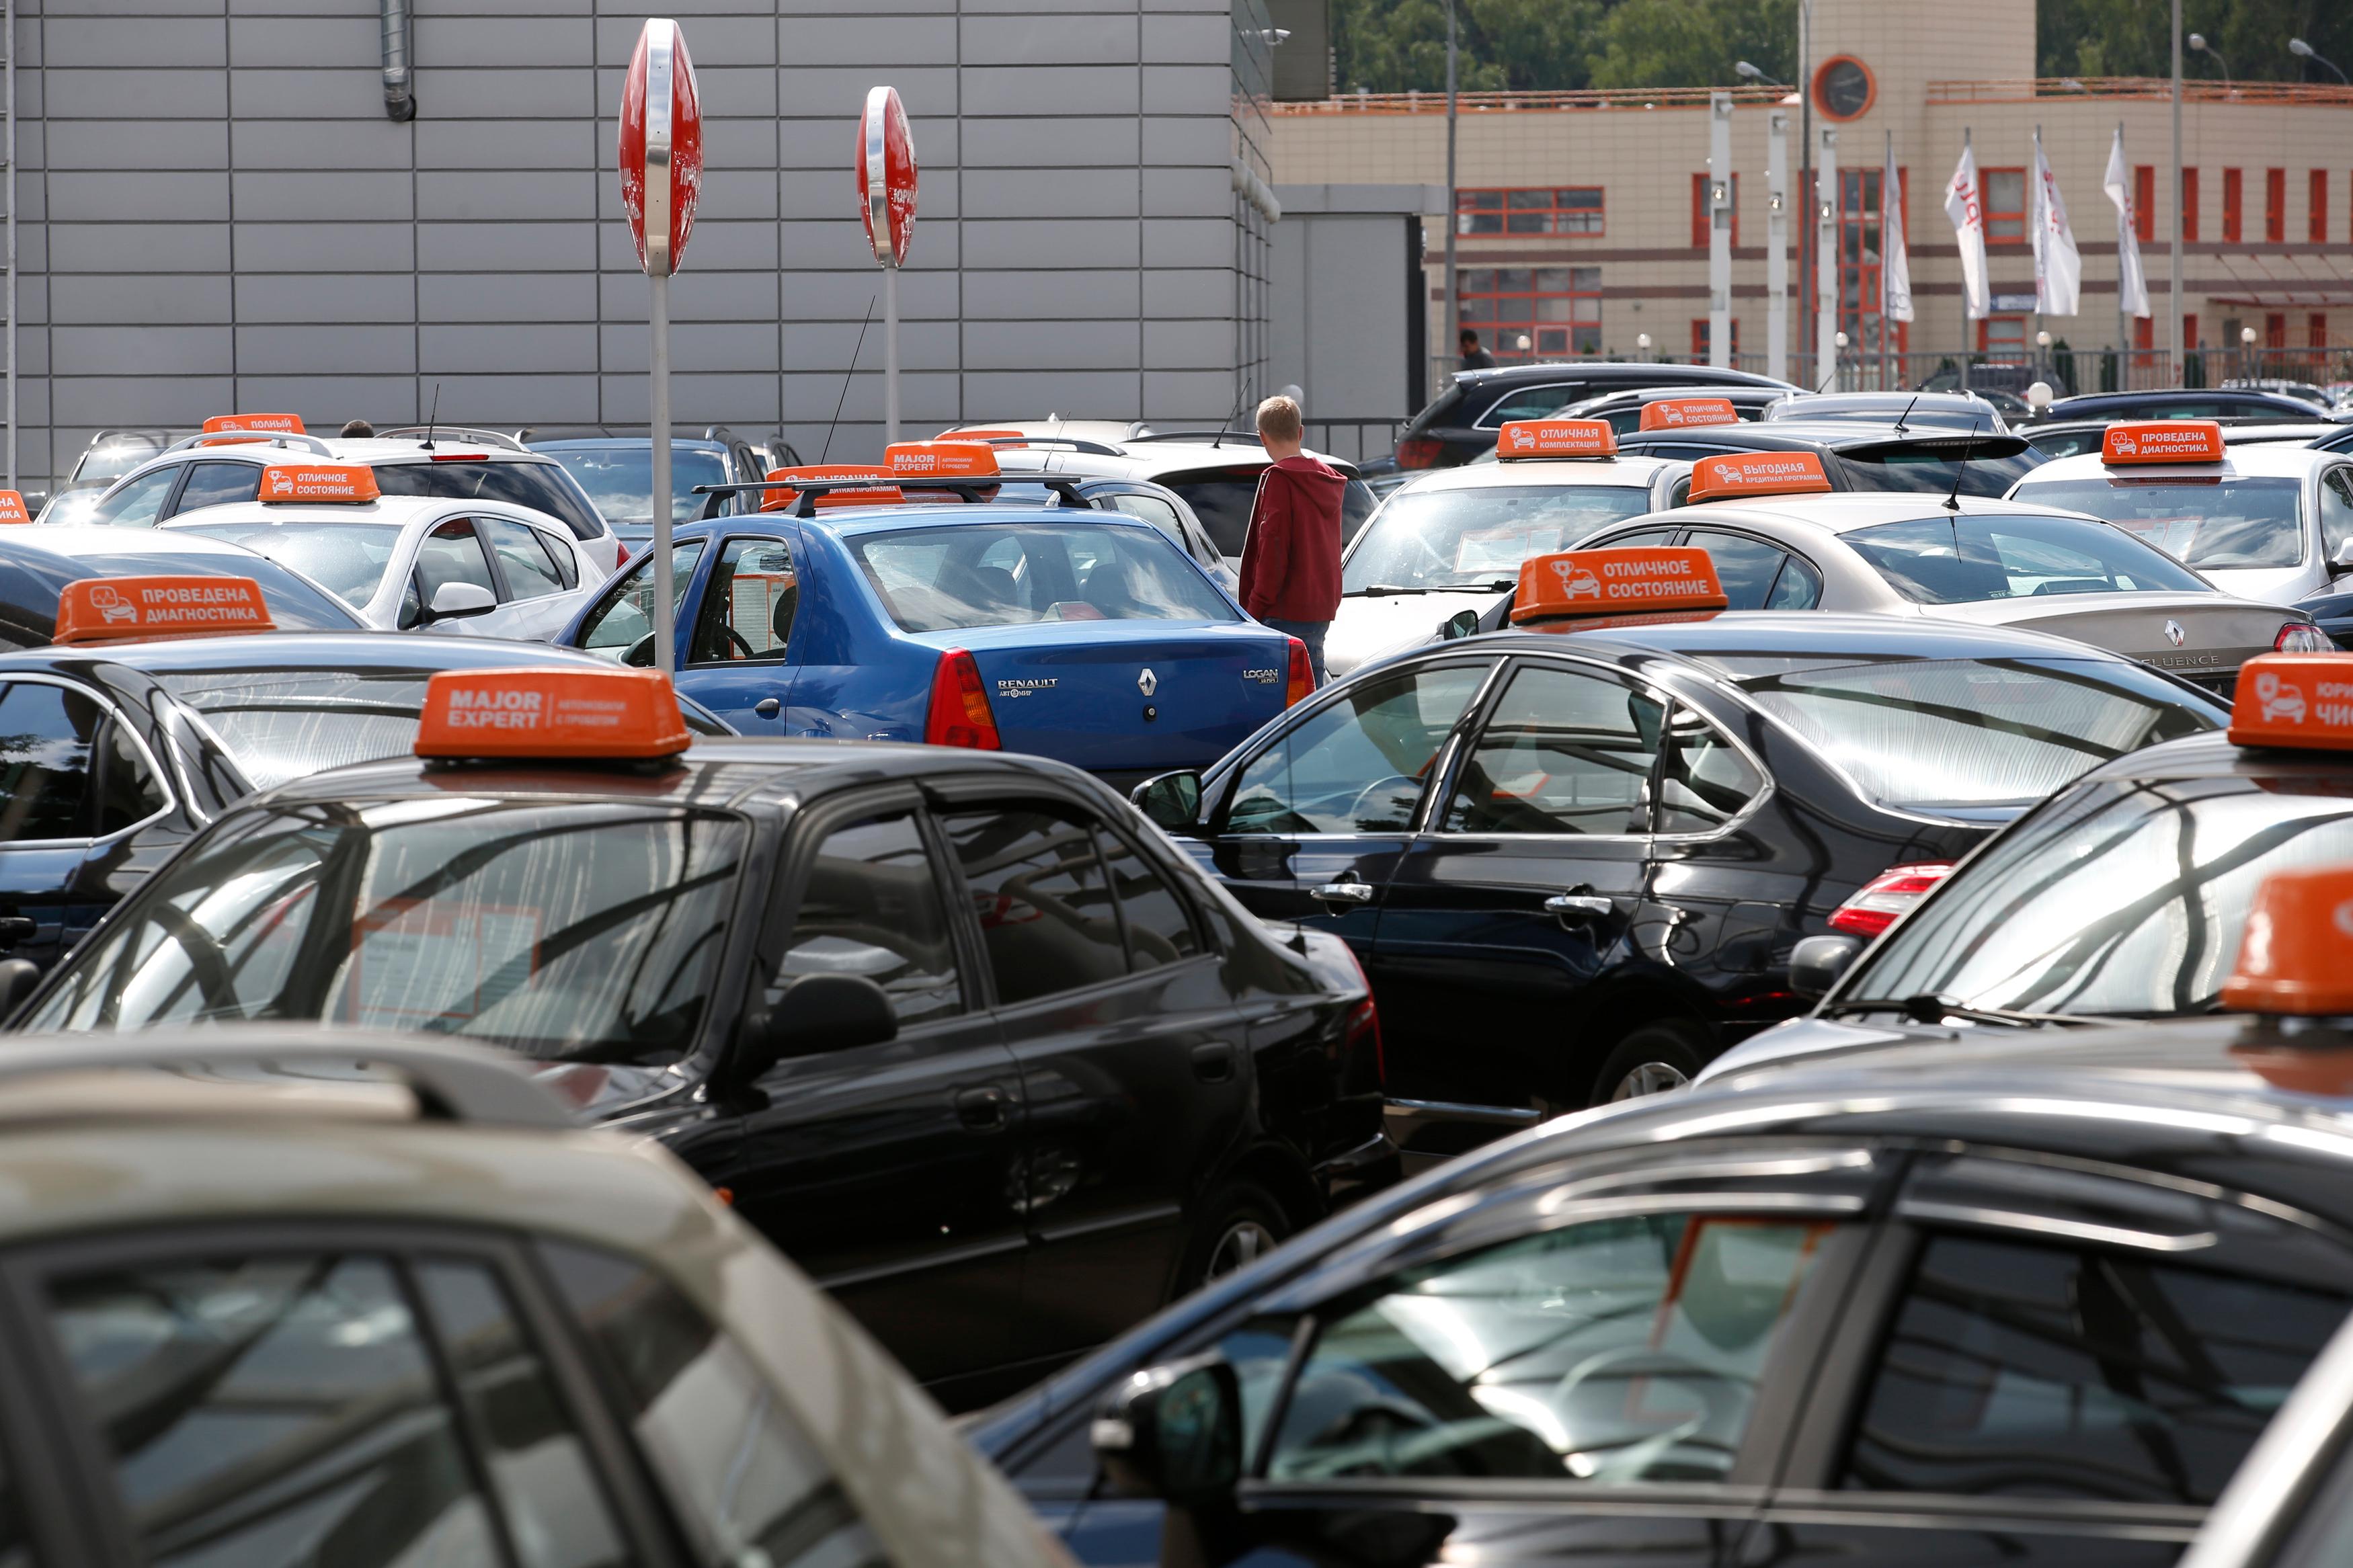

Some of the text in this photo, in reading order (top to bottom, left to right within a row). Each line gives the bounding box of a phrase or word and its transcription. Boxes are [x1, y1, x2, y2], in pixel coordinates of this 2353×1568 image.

[1683, 404, 1724, 413] ОТЛИЧНОЕ
[1686, 413, 1734, 423] СОСТОЯНИЕ
[251, 418, 292, 429] ПОЛНЫЙ
[1540, 428, 1599, 438] ОТЛИЧНАЯ
[2141, 432, 2206, 443] ПРОВЕДЕНА
[1540, 441, 1600, 449] КОМПЛЕКТАЦИЯ
[2141, 444, 2209, 454] ДИАГНОСТИКА
[894, 454, 935, 463] MAJOR
[1743, 462, 1805, 474] ВЫГОДНАЯ
[297, 473, 348, 482] ОТЛИЧНОЕ
[1746, 474, 1823, 483] КРЕДИТНАЯ ПРОГРАММА
[296, 486, 355, 495] СОСТОЯНИЕ
[0, 497, 15, 507] НА
[1603, 560, 1691, 577] ОТЛИЧНОЕ
[1607, 579, 1710, 597] СОСТОЯНИЕ
[141, 587, 250, 604] ПРОВЕДЕНА
[146, 608, 258, 623] ДИАГНОСТИКА
[1243, 669, 1278, 678] LOGAN
[998, 678, 1058, 688] RENAULT
[449, 690, 543, 710] MAJOR
[447, 710, 541, 729] EXPERT
[2315, 702, 2353, 727] ЧИ
